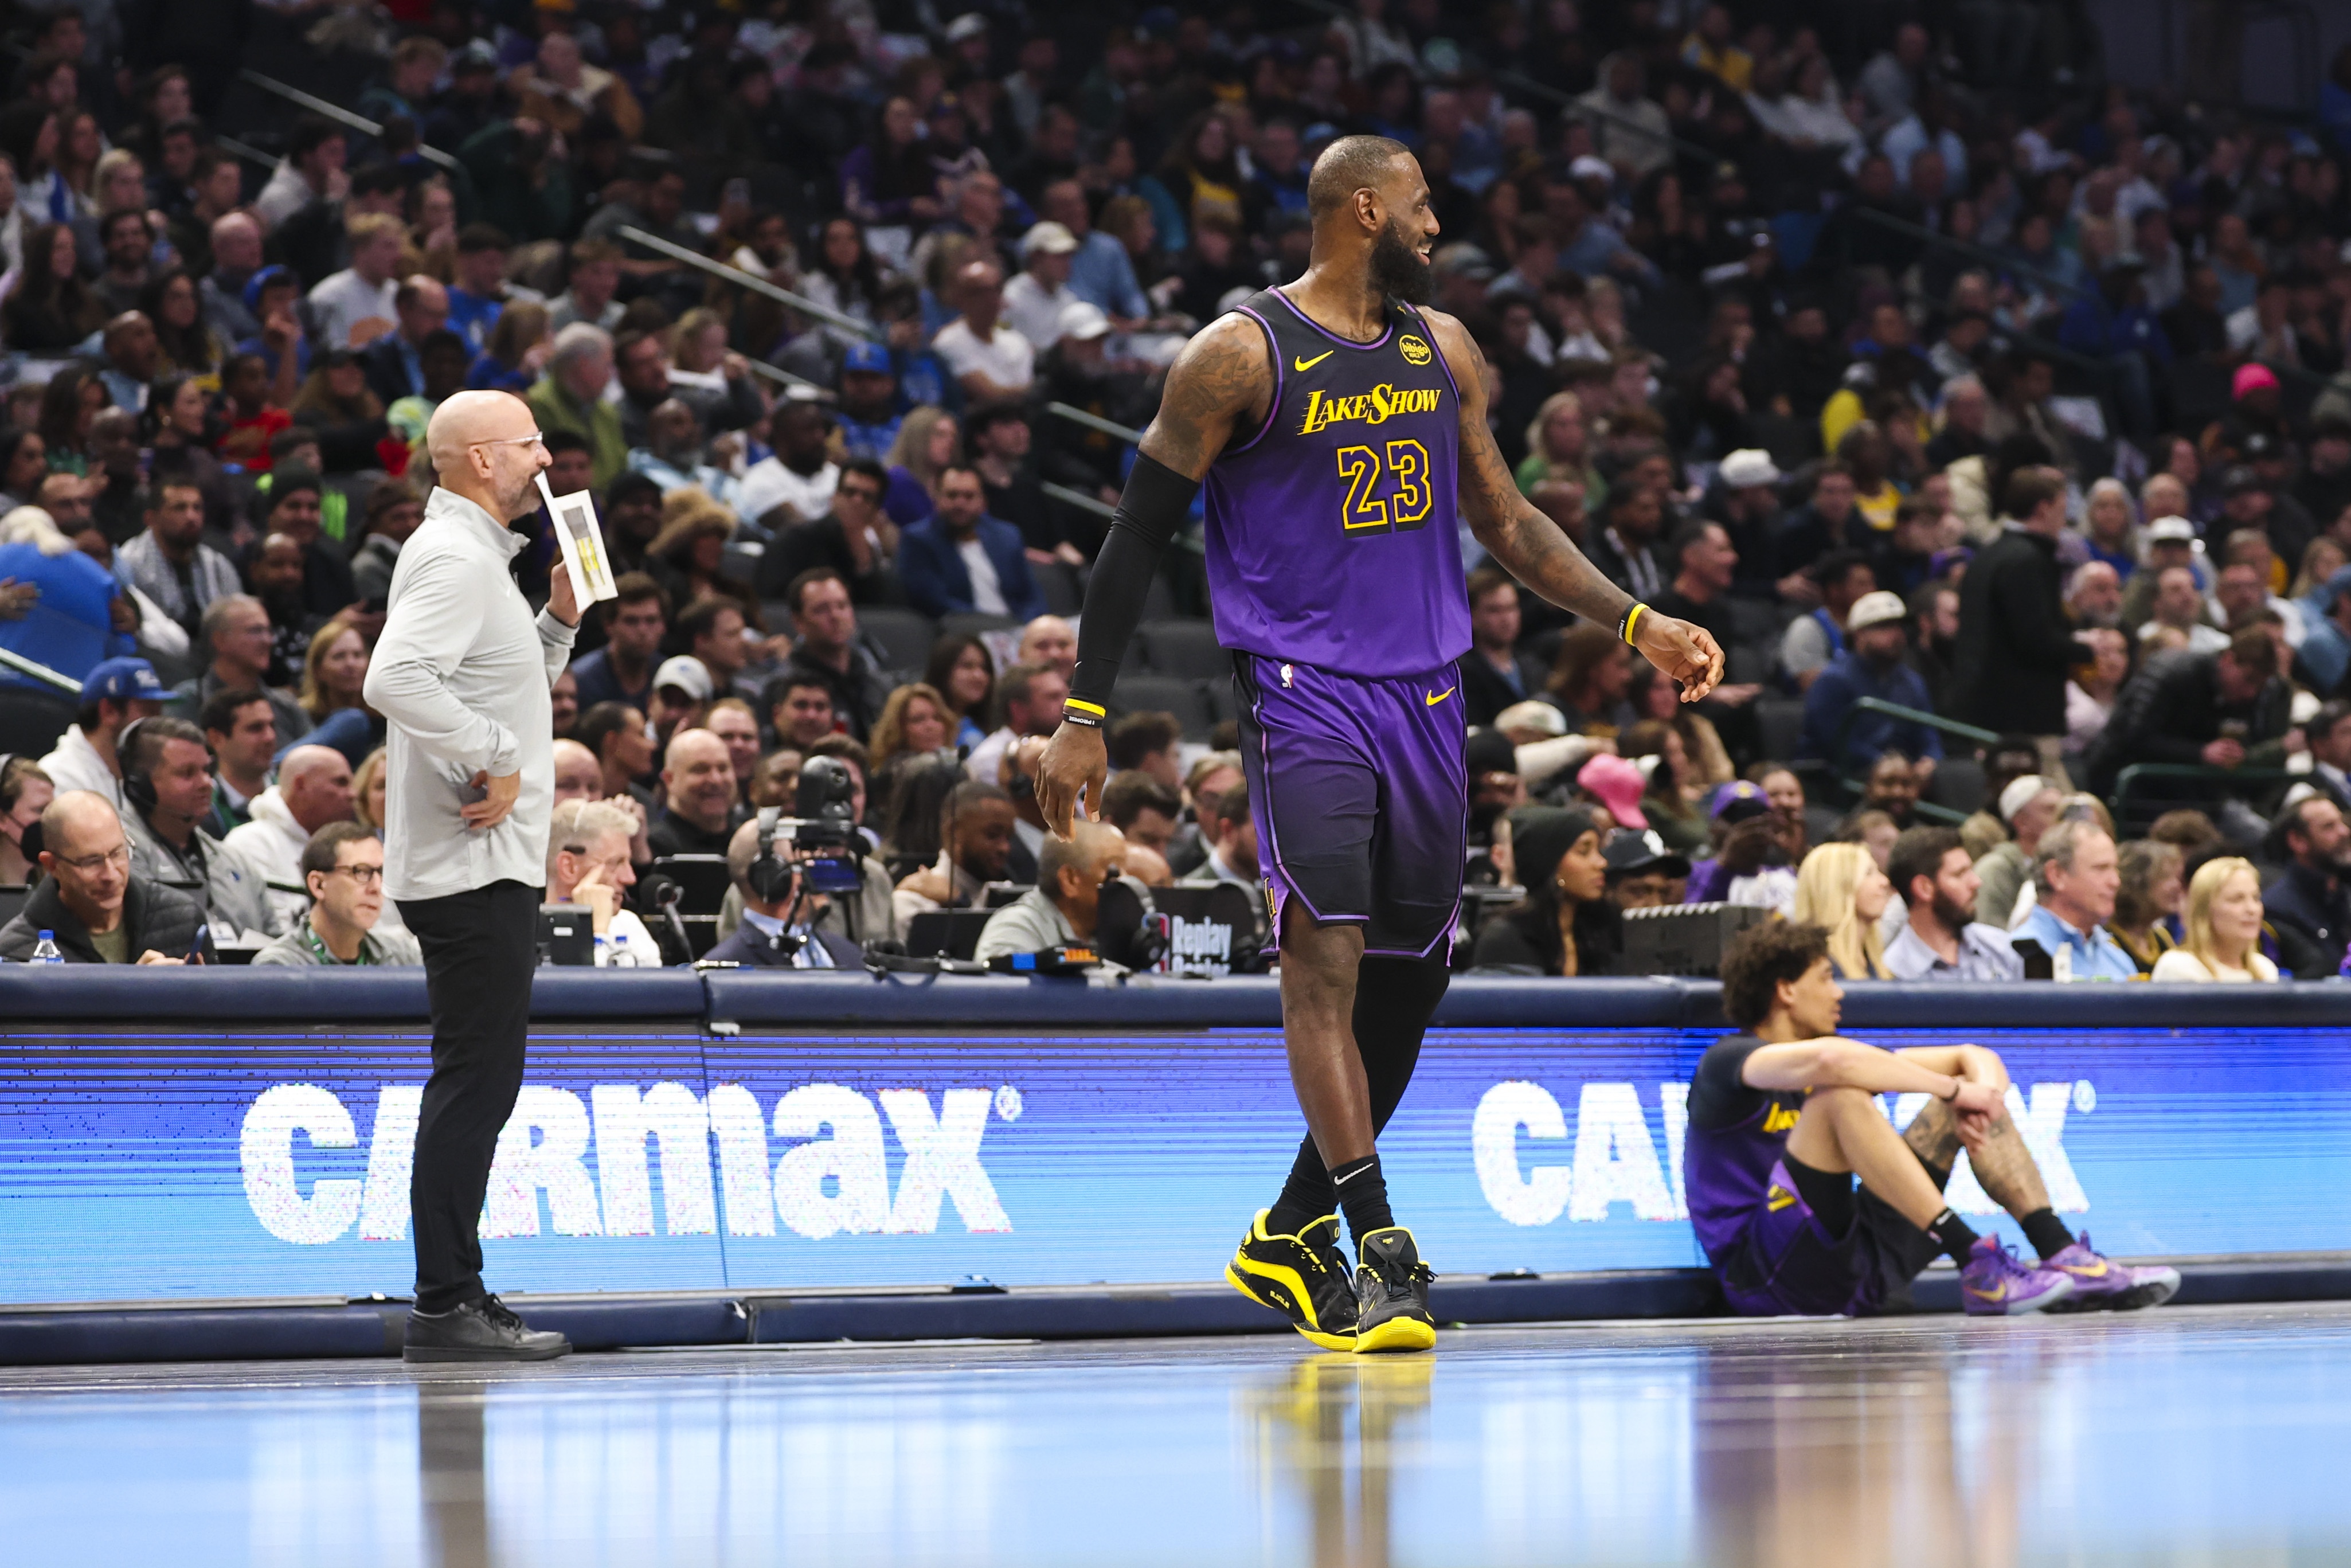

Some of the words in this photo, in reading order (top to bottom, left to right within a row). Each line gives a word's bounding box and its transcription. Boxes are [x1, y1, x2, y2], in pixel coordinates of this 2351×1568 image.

[1402, 342, 1428, 357] bibigo
[1337, 439, 1433, 533] 23
[1068, 715, 1092, 725] PROMISE
[1172, 915, 1232, 962] Replay
